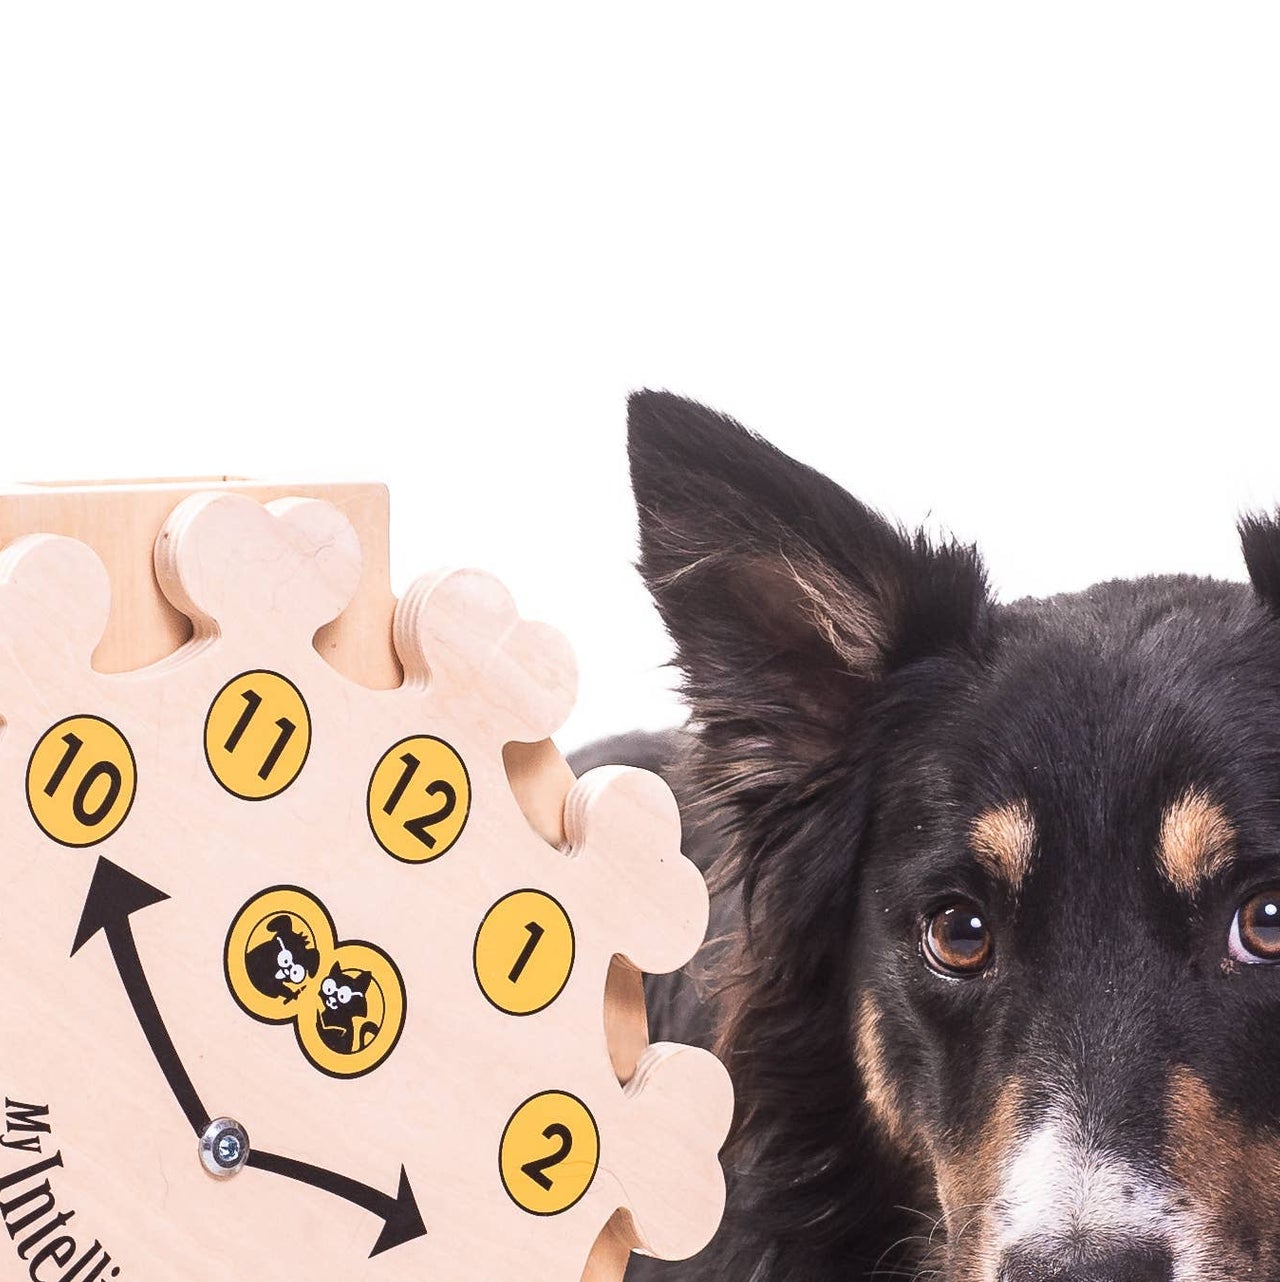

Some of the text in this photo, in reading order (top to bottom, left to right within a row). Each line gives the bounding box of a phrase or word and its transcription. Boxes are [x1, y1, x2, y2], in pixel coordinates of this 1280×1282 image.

[43, 732, 122, 827] 10
[223, 689, 297, 781] 11
[382, 752, 457, 850] 12
[508, 921, 545, 984] 1
[520, 1123, 573, 1192] 2
